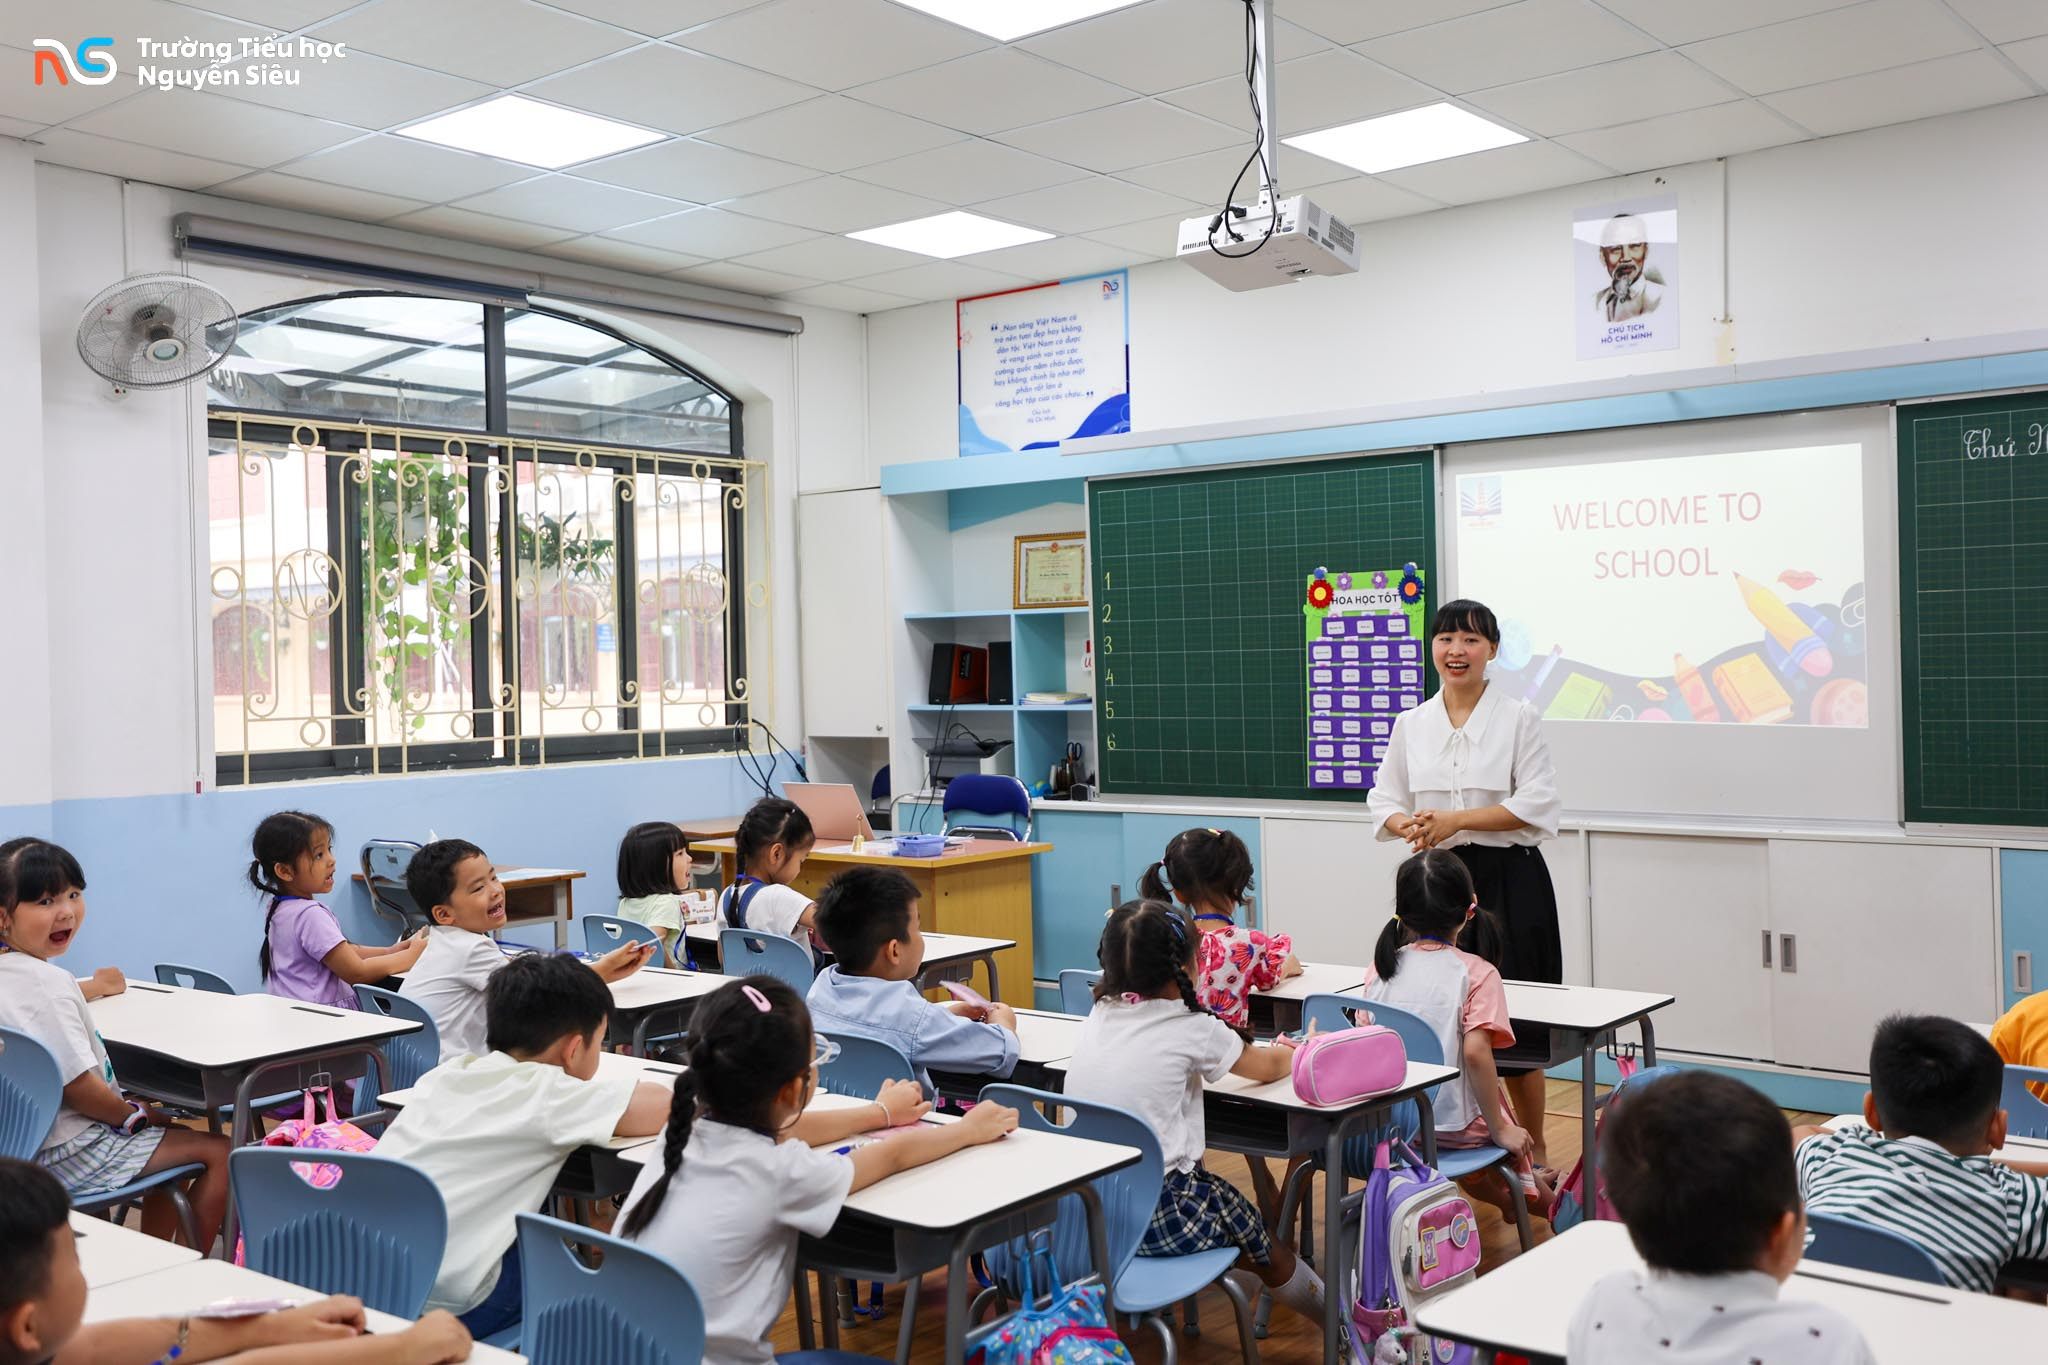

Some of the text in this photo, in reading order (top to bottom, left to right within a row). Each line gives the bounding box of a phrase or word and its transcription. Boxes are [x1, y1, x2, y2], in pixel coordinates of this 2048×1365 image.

[1627, 324, 1644, 332] TỊCH
[1631, 332, 1652, 340] MINH
[1963, 427, 2018, 460] Thứ
[1553, 490, 1762, 532] WELCOME TO
[1594, 547, 1719, 580] SCHOOL
[1104, 571, 1110, 590] 1
[1332, 591, 1398, 606] HOA HỌC TỐT
[1102, 603, 1111, 623] 2
[1104, 635, 1112, 655] 3
[1105, 668, 1114, 687] 4
[1105, 700, 1114, 719] 5
[1107, 735, 1115, 750] 6
